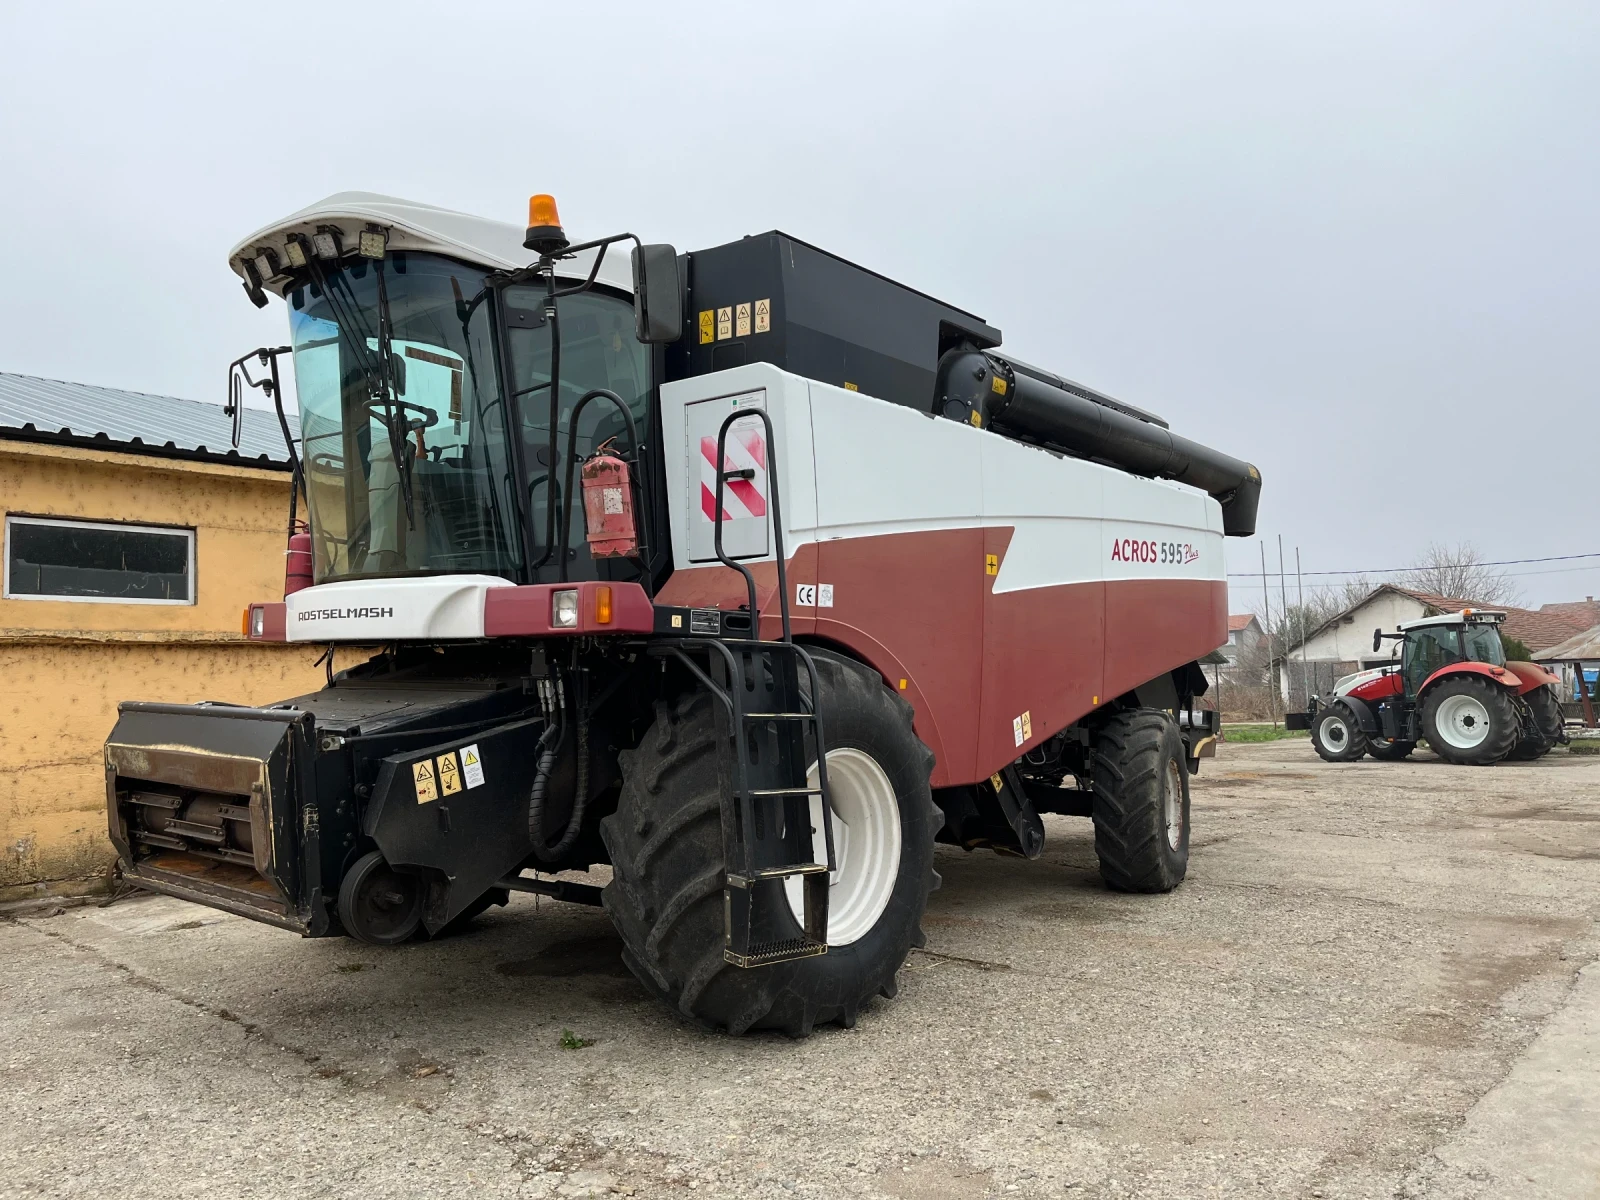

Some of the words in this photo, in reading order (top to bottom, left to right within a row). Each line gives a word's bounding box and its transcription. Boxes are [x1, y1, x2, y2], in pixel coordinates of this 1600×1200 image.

[1111, 538, 1158, 563] ACROS
[1160, 542, 1183, 564] 595
[1183, 543, 1199, 561] Plus
[798, 586, 813, 604] CE
[298, 607, 393, 622] ROSTSELMASH
